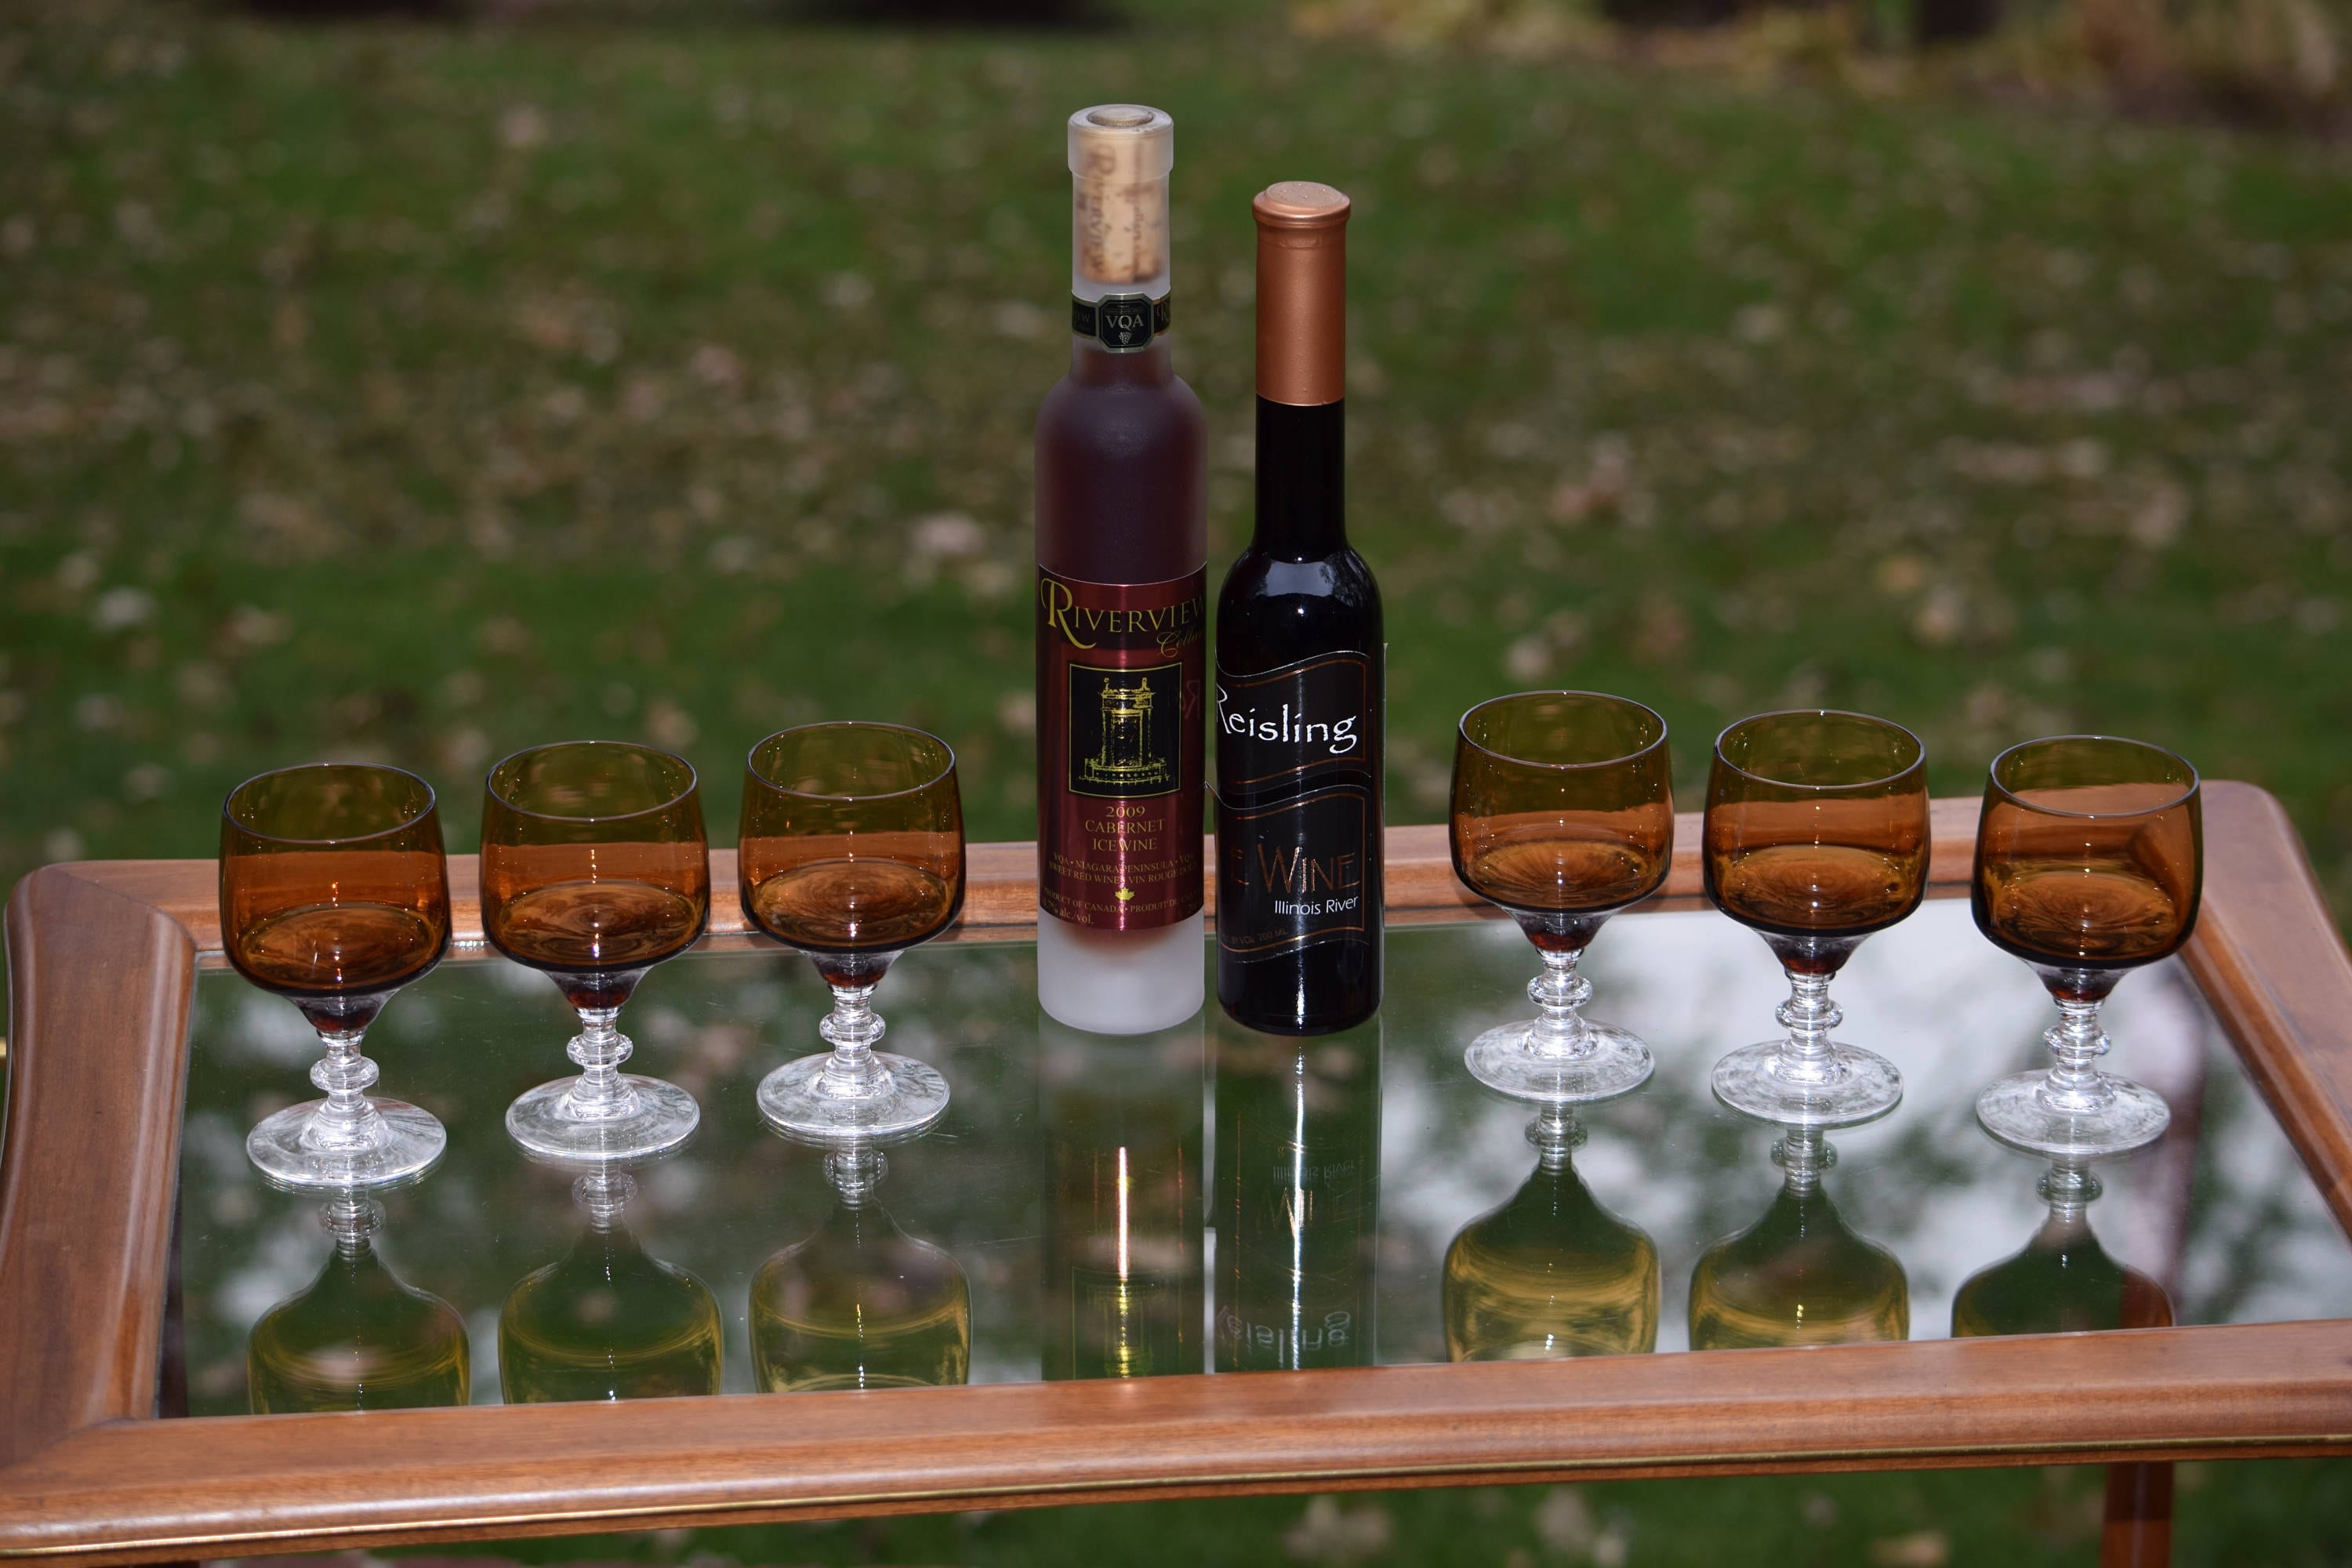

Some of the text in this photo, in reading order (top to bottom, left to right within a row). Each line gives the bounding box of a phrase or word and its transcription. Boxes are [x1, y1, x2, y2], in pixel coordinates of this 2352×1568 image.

[1105, 314, 1144, 331] VQA
[1105, 806, 1145, 818] 2009
[1085, 819, 1165, 834] CABERNET
[1093, 838, 1157, 852] ICEWINE
[1054, 852, 1069, 864] VQA
[1076, 860, 1120, 873] NIAGARA
[1122, 859, 1174, 873] PENINSULA
[1257, 842, 1360, 893] WINE
[1073, 871, 1091, 881] RED
[1148, 870, 1178, 883] ROUGE
[1084, 902, 1123, 913] CANADA
[1131, 901, 1167, 913] PRODUIT
[1275, 896, 1359, 915] Illinois River
